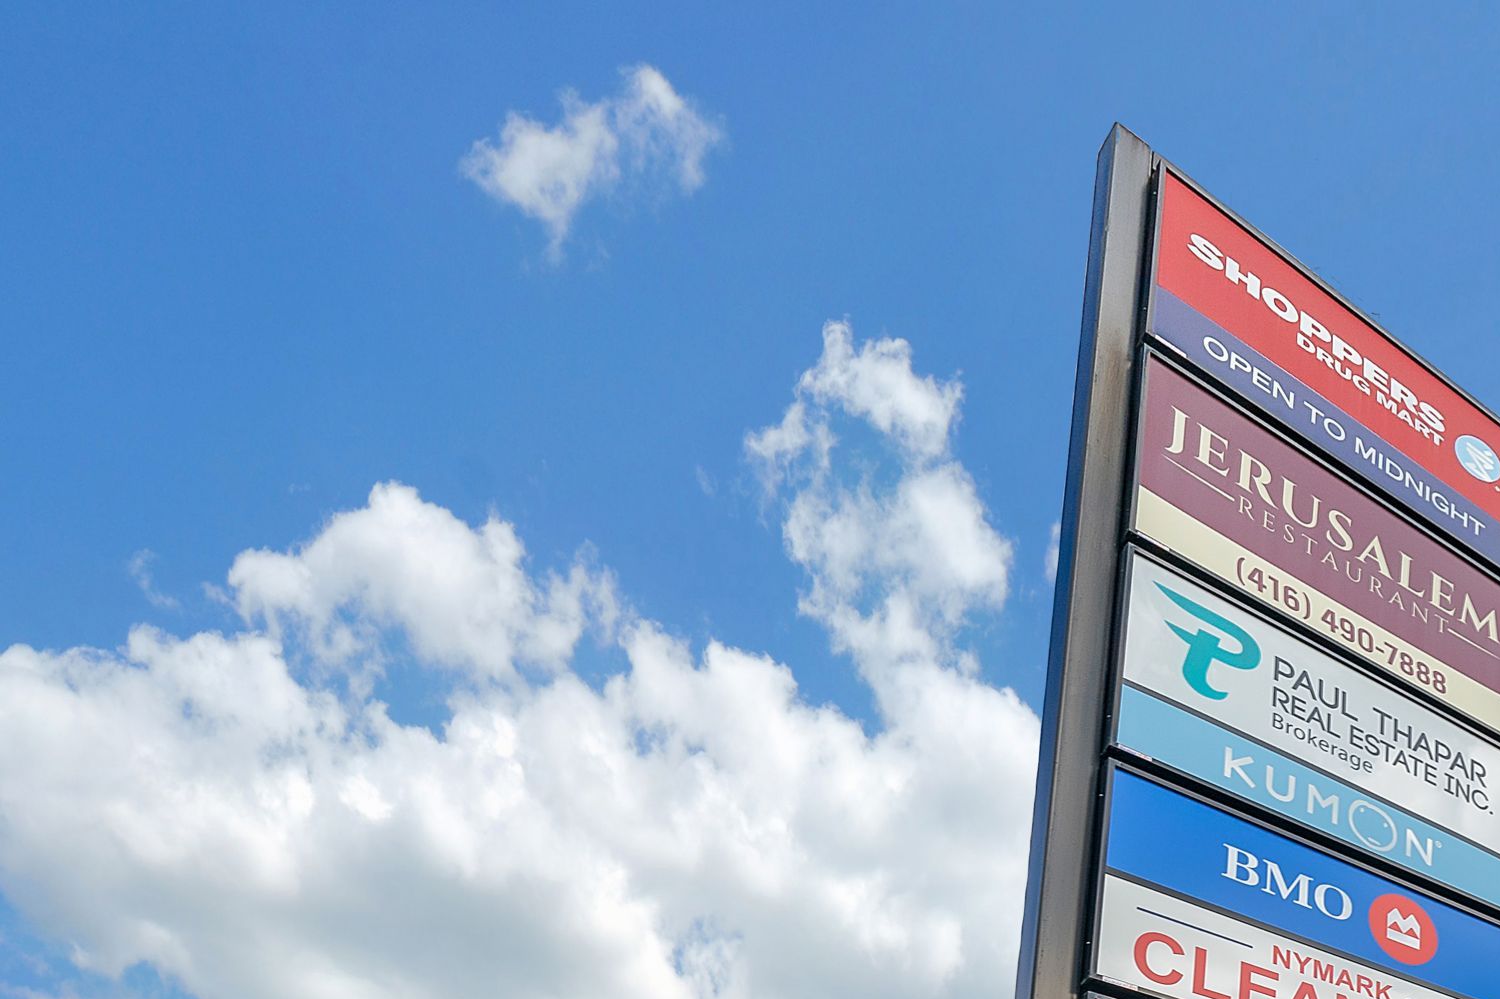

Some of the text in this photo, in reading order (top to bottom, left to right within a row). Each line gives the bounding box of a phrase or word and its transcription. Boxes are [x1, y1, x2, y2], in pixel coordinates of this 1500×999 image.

[1187, 233, 1446, 434] SHOPPERS
[1296, 332, 1445, 447] DRUG MART
[1203, 336, 1486, 536] OPEN TO MIDNIGHT
[1165, 405, 1500, 644] JERUSALEM
[1238, 497, 1450, 633] RESTAURANT
[1236, 556, 1447, 695] (416) 490-7888
[1272, 713, 1374, 775] Brokerage
[1272, 686, 1495, 815] REAL ESTATE INC.
[1273, 656, 1487, 789] PAUL THAPAR
[1224, 746, 1434, 867] KUMON
[1221, 843, 1353, 921] BMO
